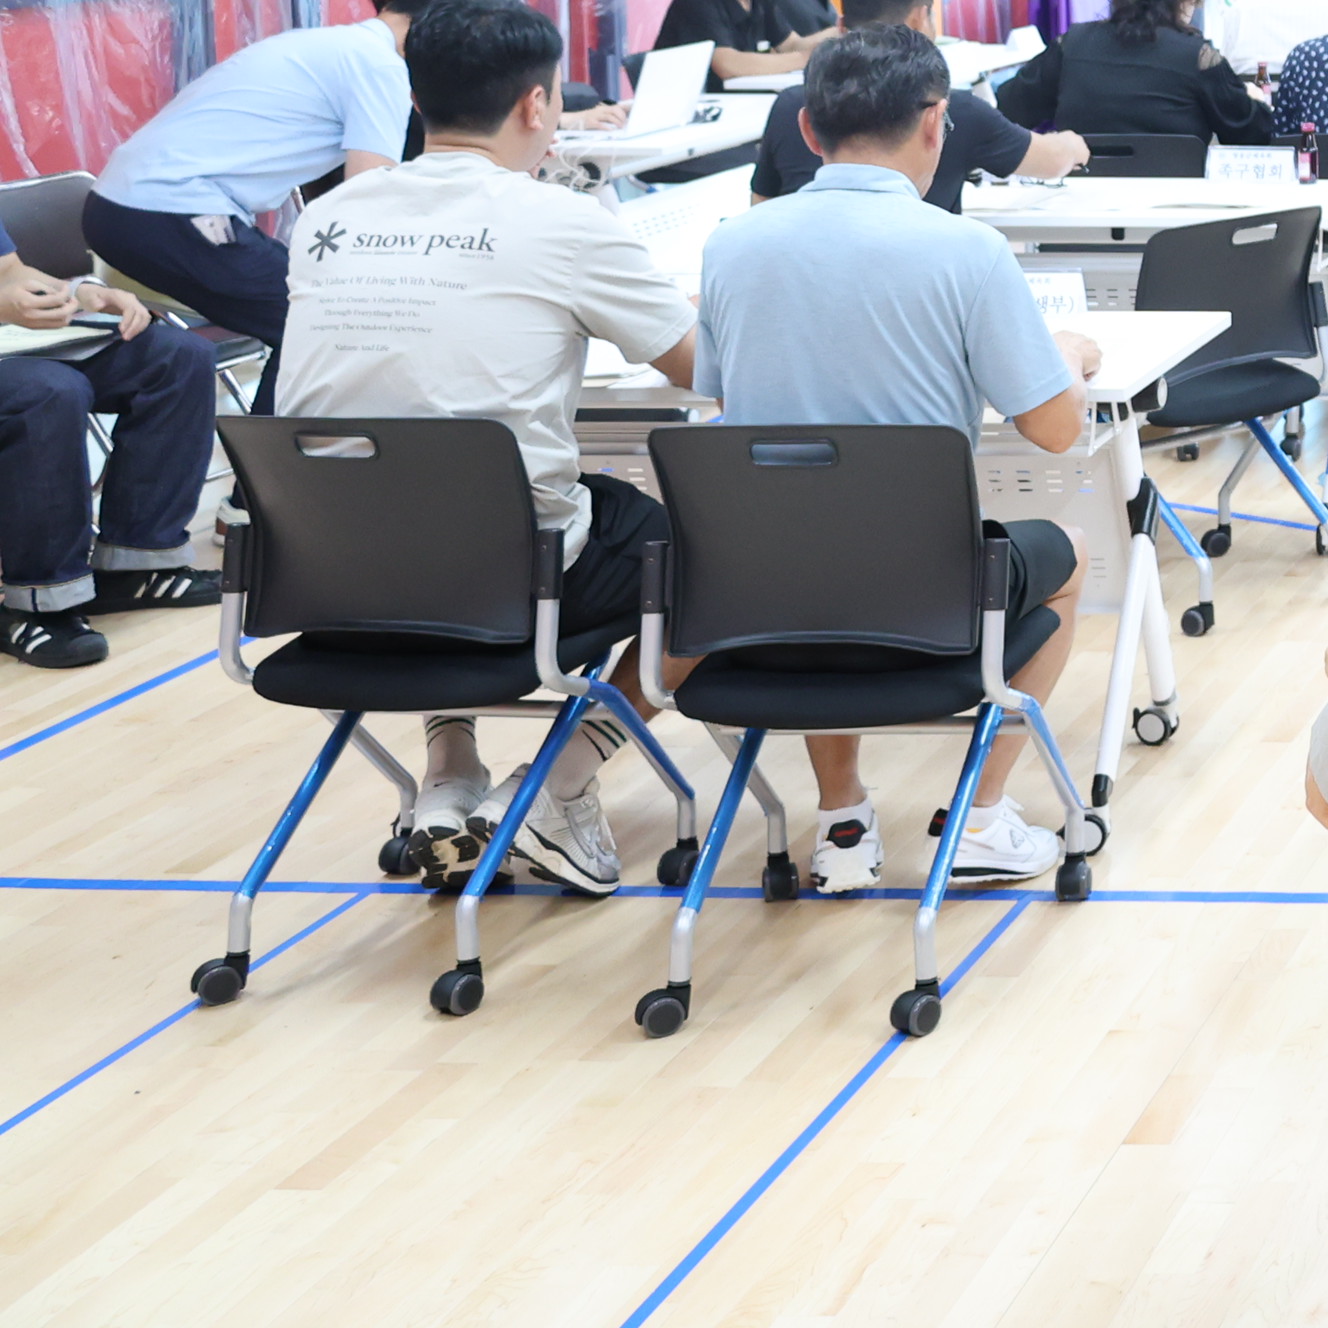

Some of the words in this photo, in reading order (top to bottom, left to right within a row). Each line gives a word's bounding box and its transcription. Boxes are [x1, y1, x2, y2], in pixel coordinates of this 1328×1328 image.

[353, 233, 423, 248] snow
[422, 227, 498, 256] peak
[366, 275, 397, 287] Living
[400, 276, 426, 286] With
[428, 277, 468, 290] Nature
